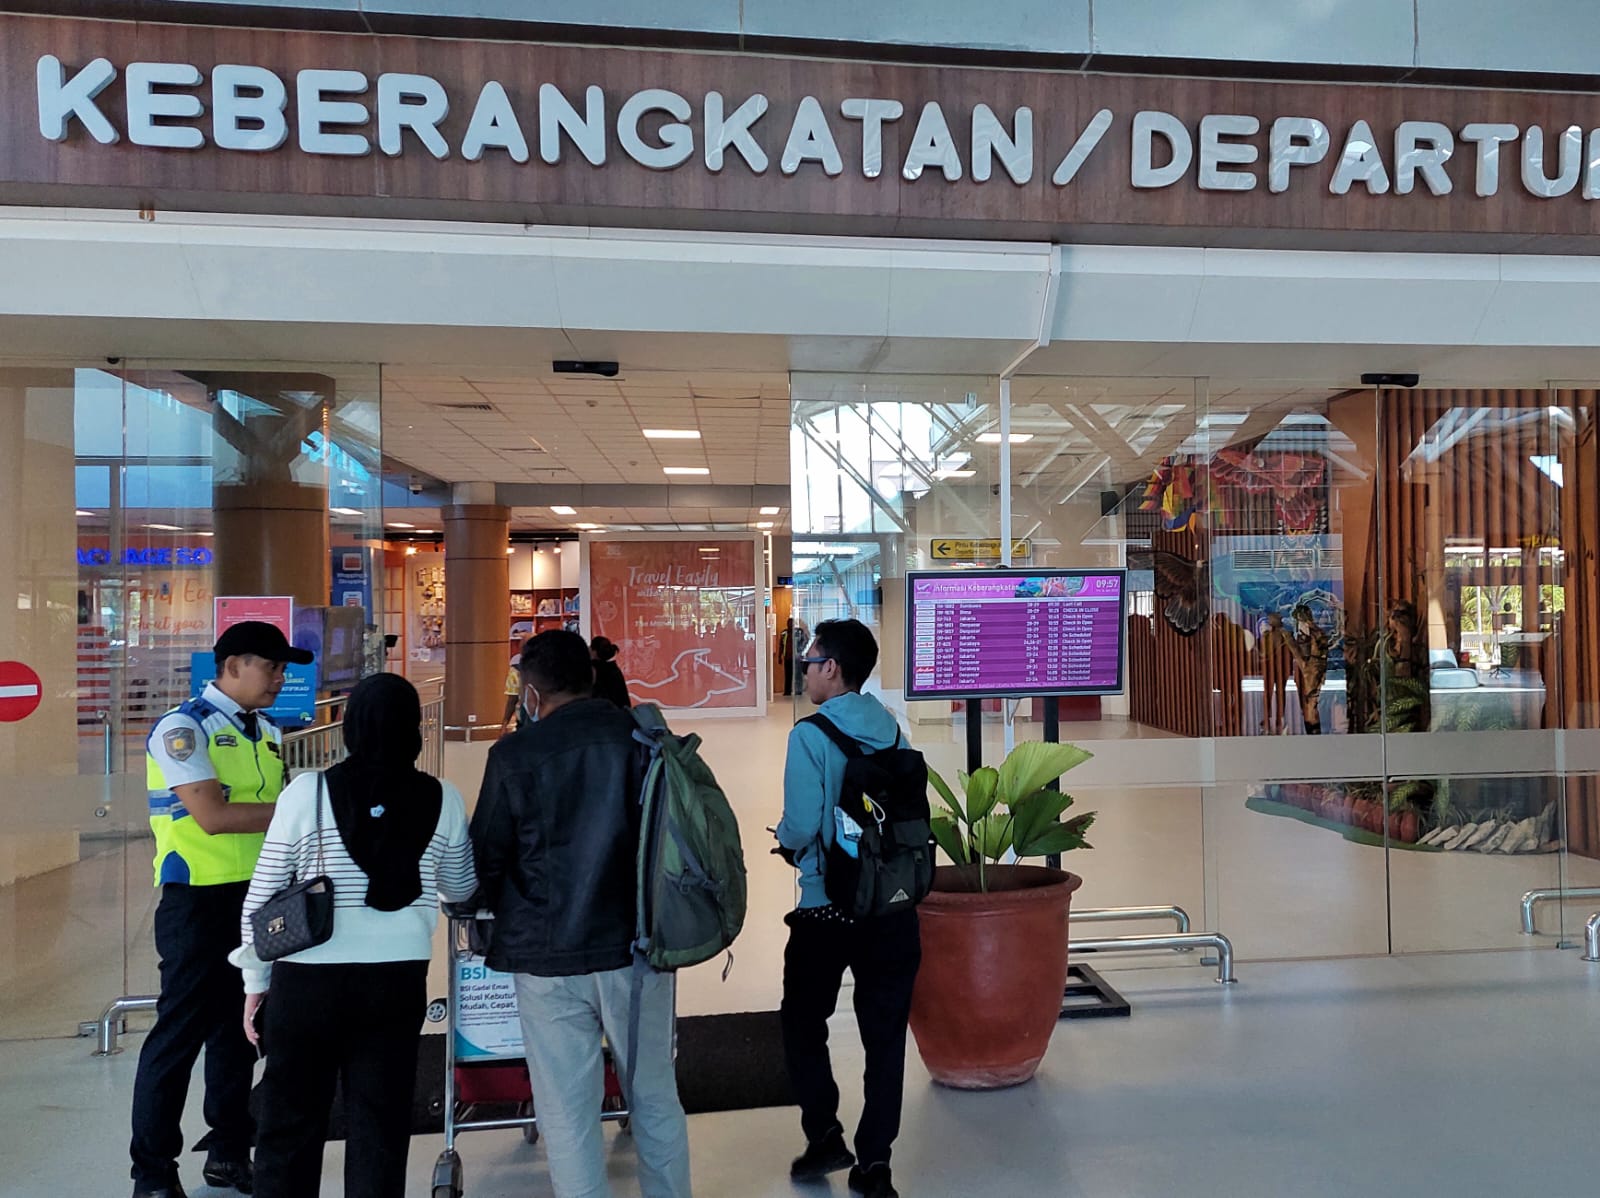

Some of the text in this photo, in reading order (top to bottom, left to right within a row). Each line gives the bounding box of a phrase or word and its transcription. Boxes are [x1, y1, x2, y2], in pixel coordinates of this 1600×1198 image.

[36, 54, 1034, 185] KEBERANGKATAN
[1052, 108, 1114, 187] /
[627, 564, 719, 588] Travel Easily
[1095, 579, 1119, 589] 09:57
[461, 967, 487, 981] BSI
[460, 993, 483, 1002] Solusi
